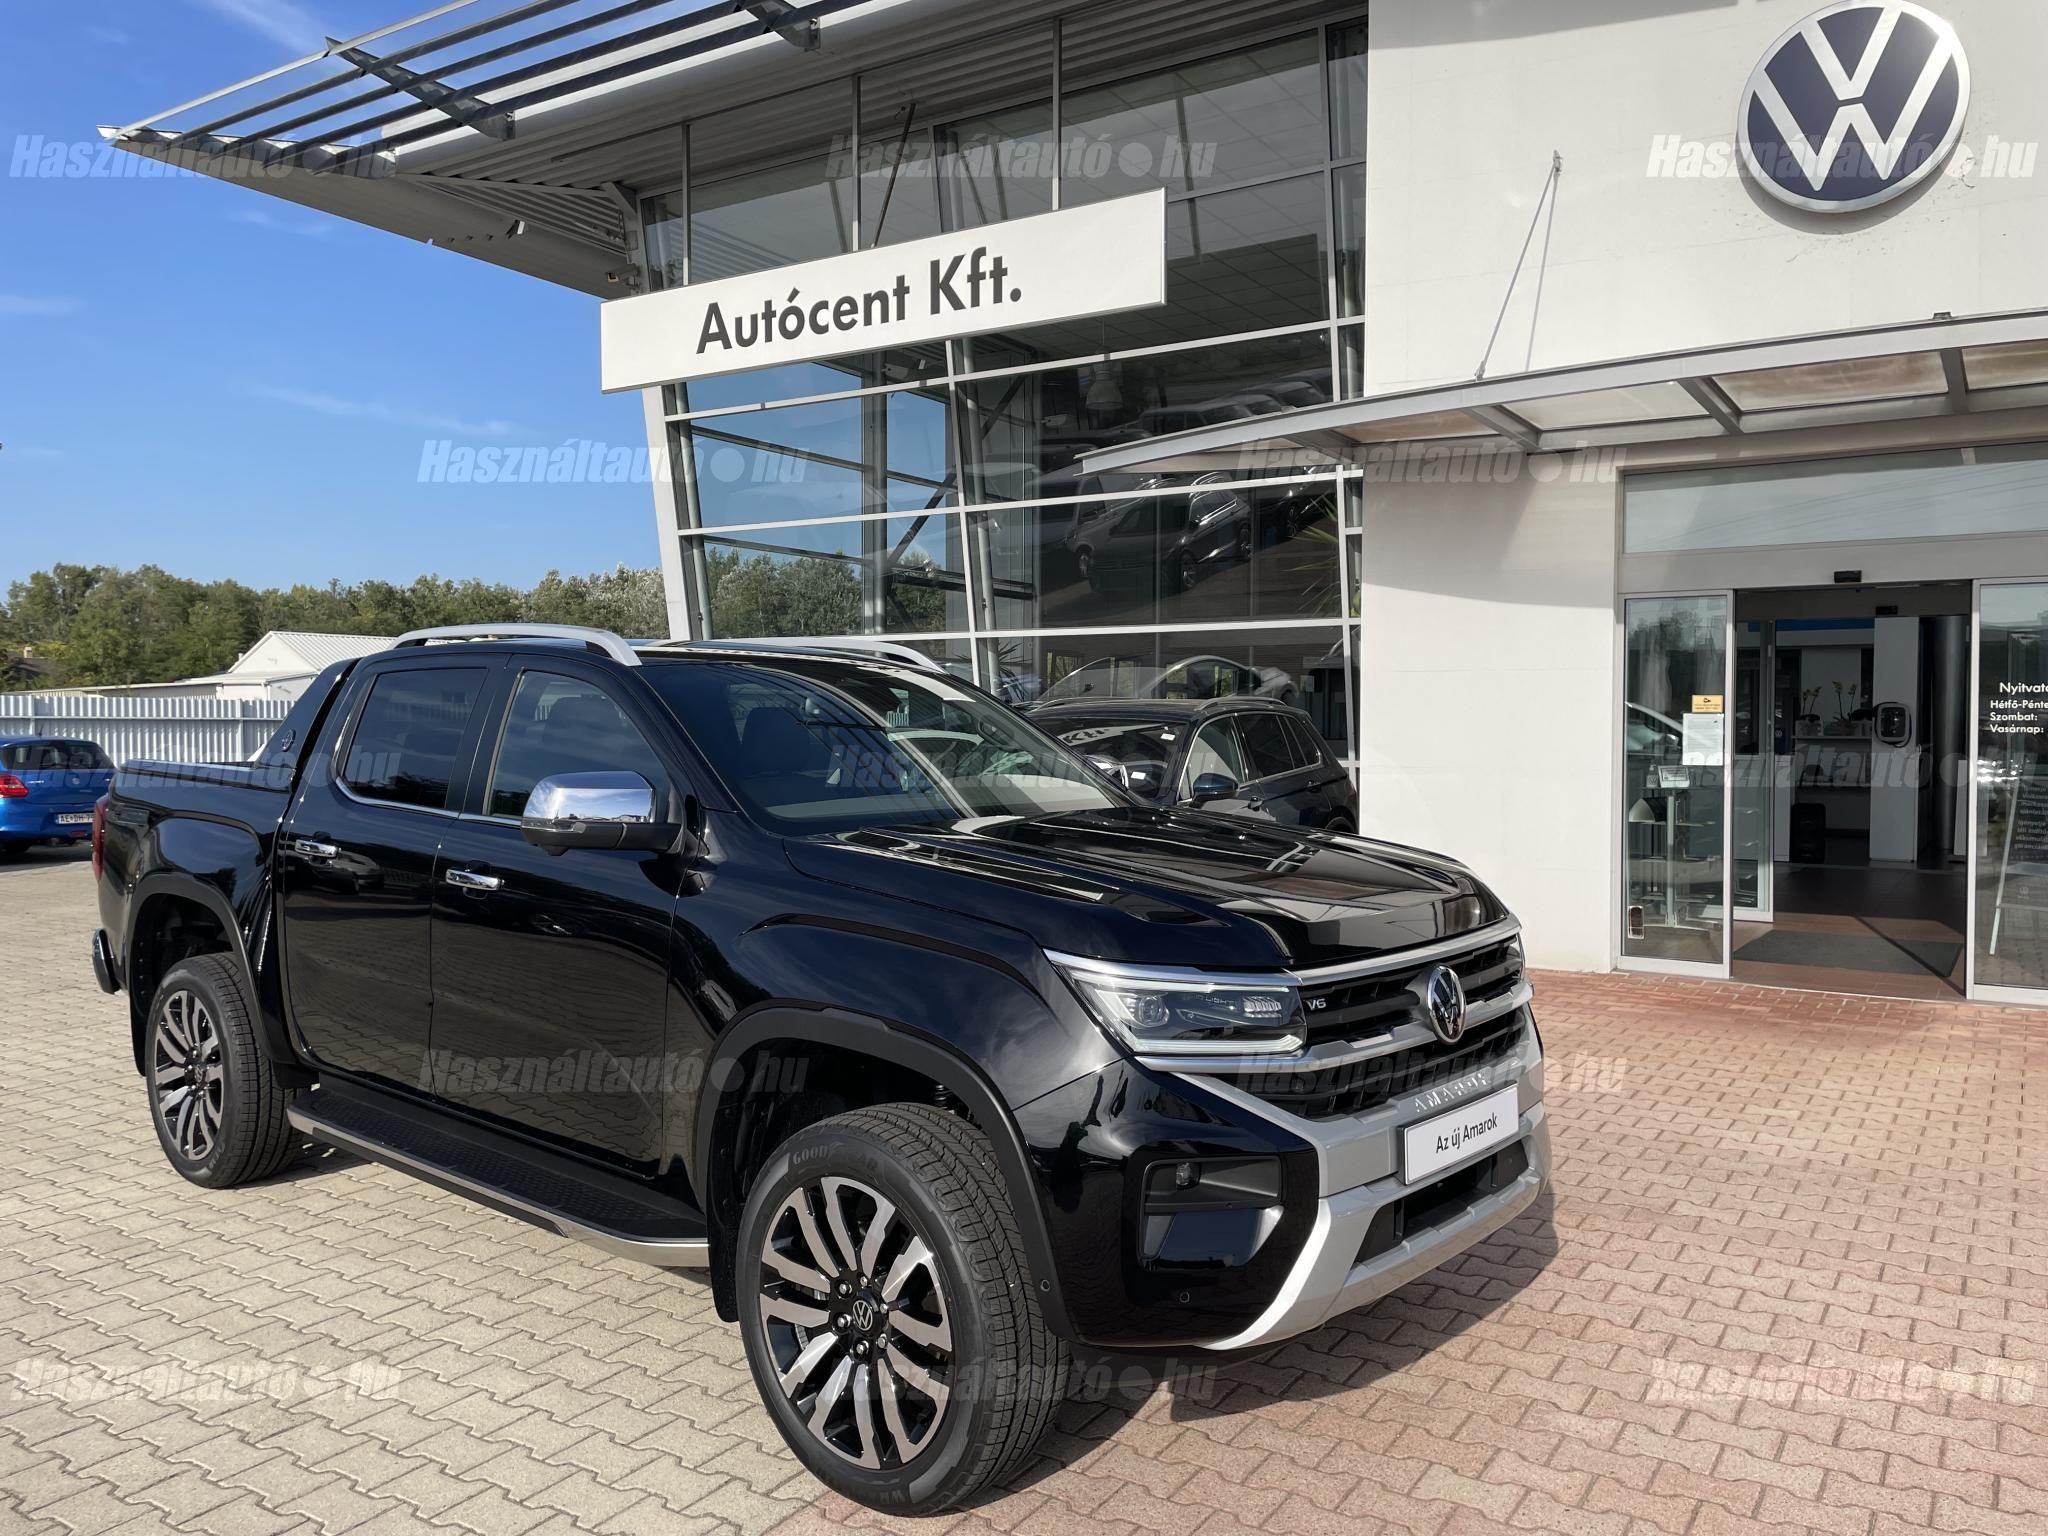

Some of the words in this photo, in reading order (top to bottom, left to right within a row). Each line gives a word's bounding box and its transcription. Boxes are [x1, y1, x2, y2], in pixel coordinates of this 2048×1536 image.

[696, 275, 910, 354] Autócent
[930, 247, 1022, 315] Kft.
[1990, 712, 2038, 721] Szombat:
[1990, 724, 2044, 735] Vasárnap:
[1305, 998, 1327, 1011] V6
[1436, 1135, 1449, 1154] Az
[1451, 1127, 1460, 1149] új
[1462, 1112, 1498, 1142] Amarok
